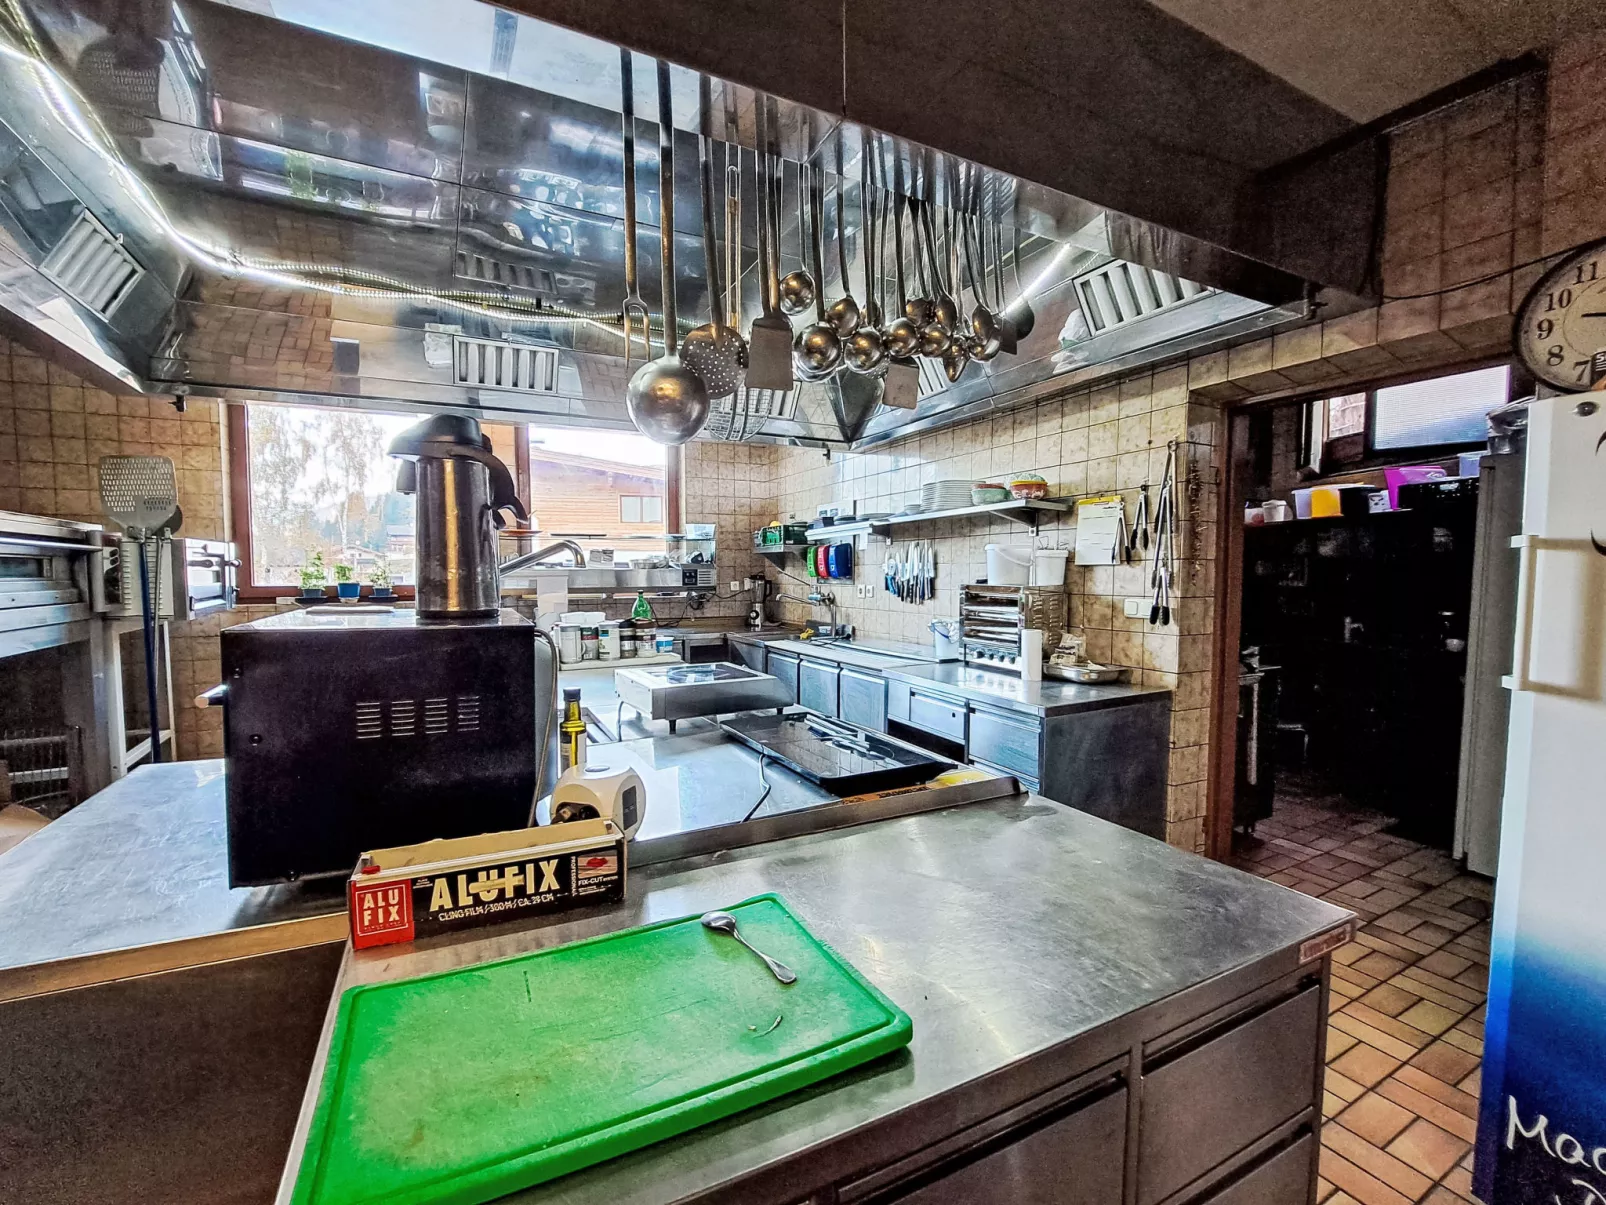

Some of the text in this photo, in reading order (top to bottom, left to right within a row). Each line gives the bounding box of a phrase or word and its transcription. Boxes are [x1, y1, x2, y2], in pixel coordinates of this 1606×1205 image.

[1573, 261, 1599, 285] 11
[1545, 288, 1572, 312] 10
[1537, 318, 1554, 340] 9
[1547, 345, 1564, 367] 8
[1573, 359, 1591, 382] 7
[429, 859, 560, 912] ALUFIX
[578, 876, 604, 886] FIX-CUT
[363, 888, 399, 910] ALU
[363, 905, 400, 927] FIX
[438, 909, 465, 922] CLING
[465, 905, 484, 917] FILM
